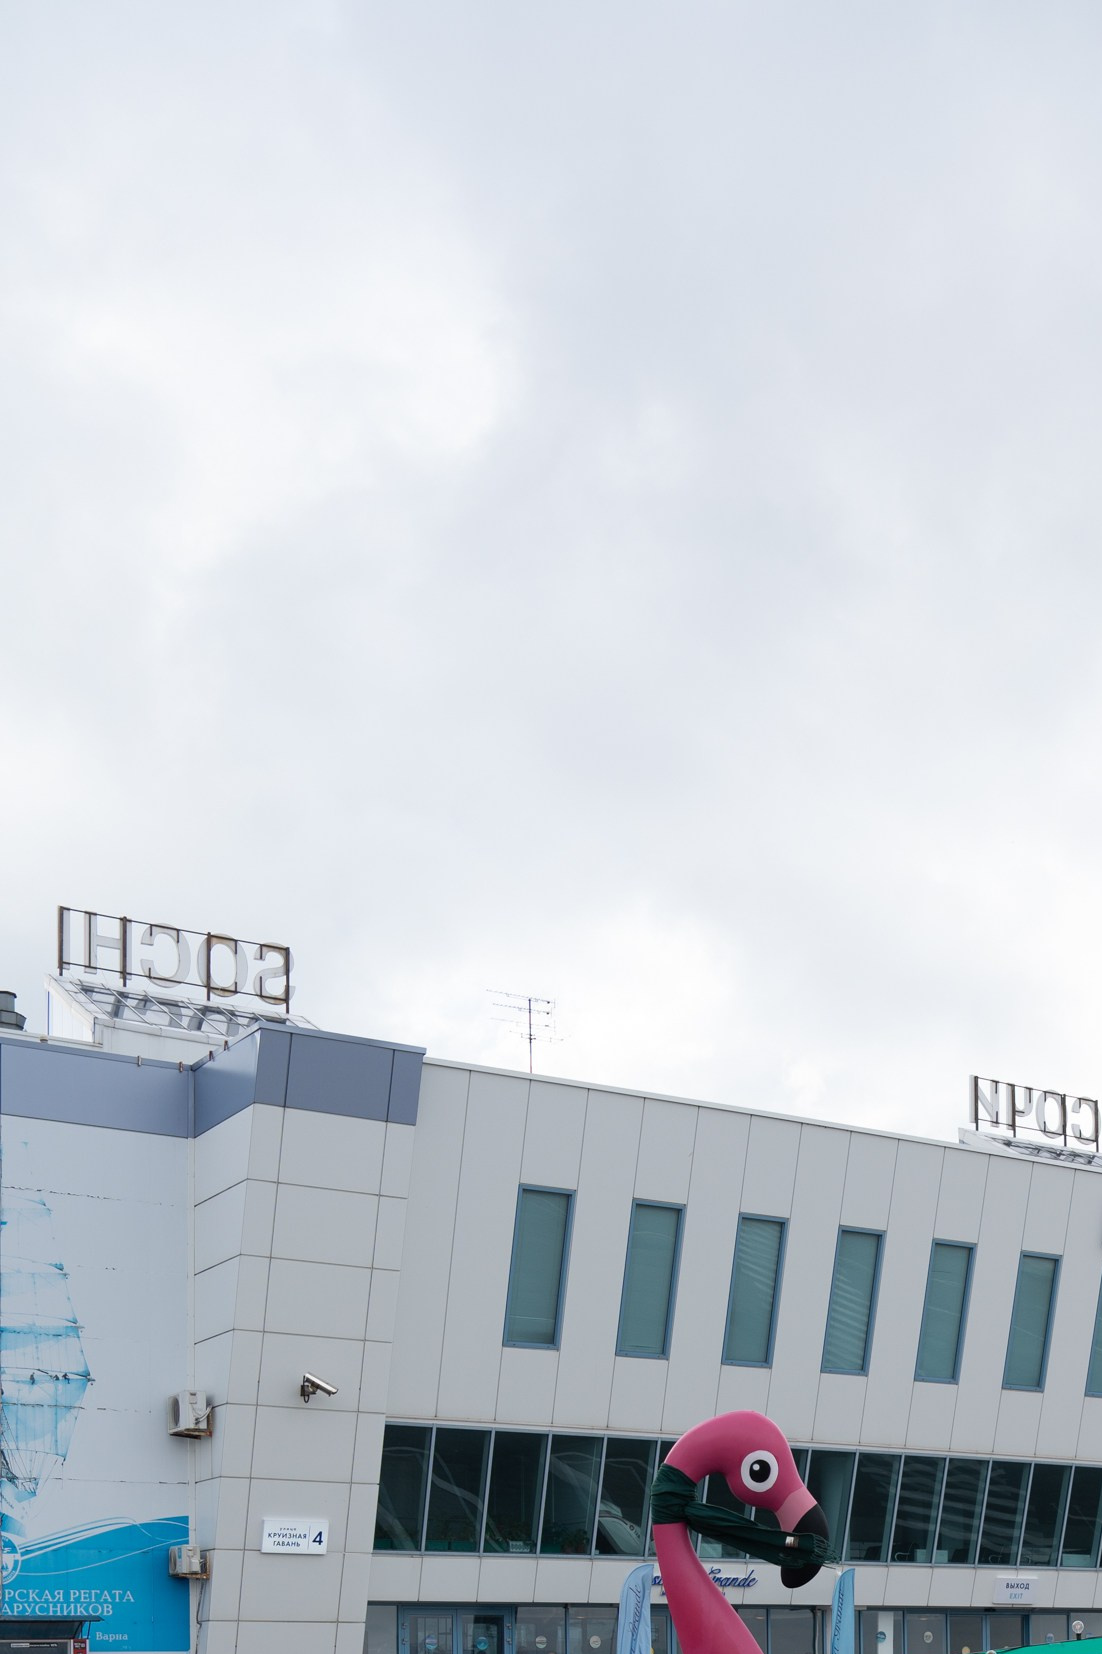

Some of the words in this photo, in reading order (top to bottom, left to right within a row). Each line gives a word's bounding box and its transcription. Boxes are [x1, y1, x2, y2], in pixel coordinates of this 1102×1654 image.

[267, 1532, 307, 1540] КРУИЗНАЯ
[312, 1530, 324, 1546] 4
[273, 1540, 301, 1548] ГАВАНЬ
[1005, 1582, 1030, 1591] ВЫХОД
[0, 1589, 63, 1602] РСКАЯ
[70, 1589, 135, 1603] РЕГАТА
[1009, 1592, 1024, 1600] EXIT
[96, 1631, 128, 1642] Варна
